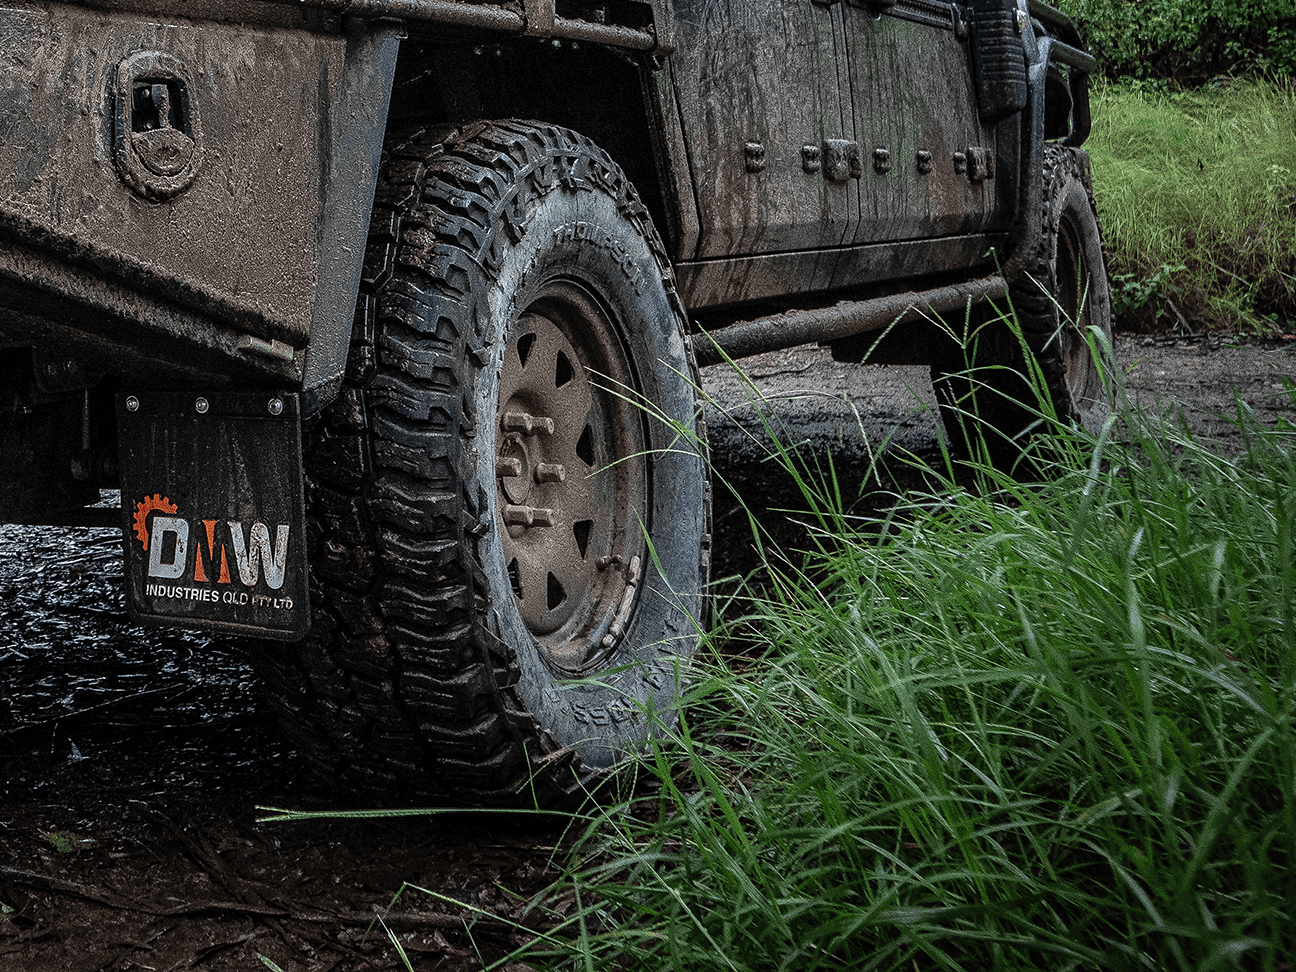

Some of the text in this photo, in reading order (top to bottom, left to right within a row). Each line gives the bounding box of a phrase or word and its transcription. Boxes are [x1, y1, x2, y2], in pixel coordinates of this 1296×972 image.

[148, 516, 291, 590] DMW
[145, 584, 220, 603] INDUSTRIES
[222, 592, 249, 606] QLD
[273, 598, 294, 610] LTD
